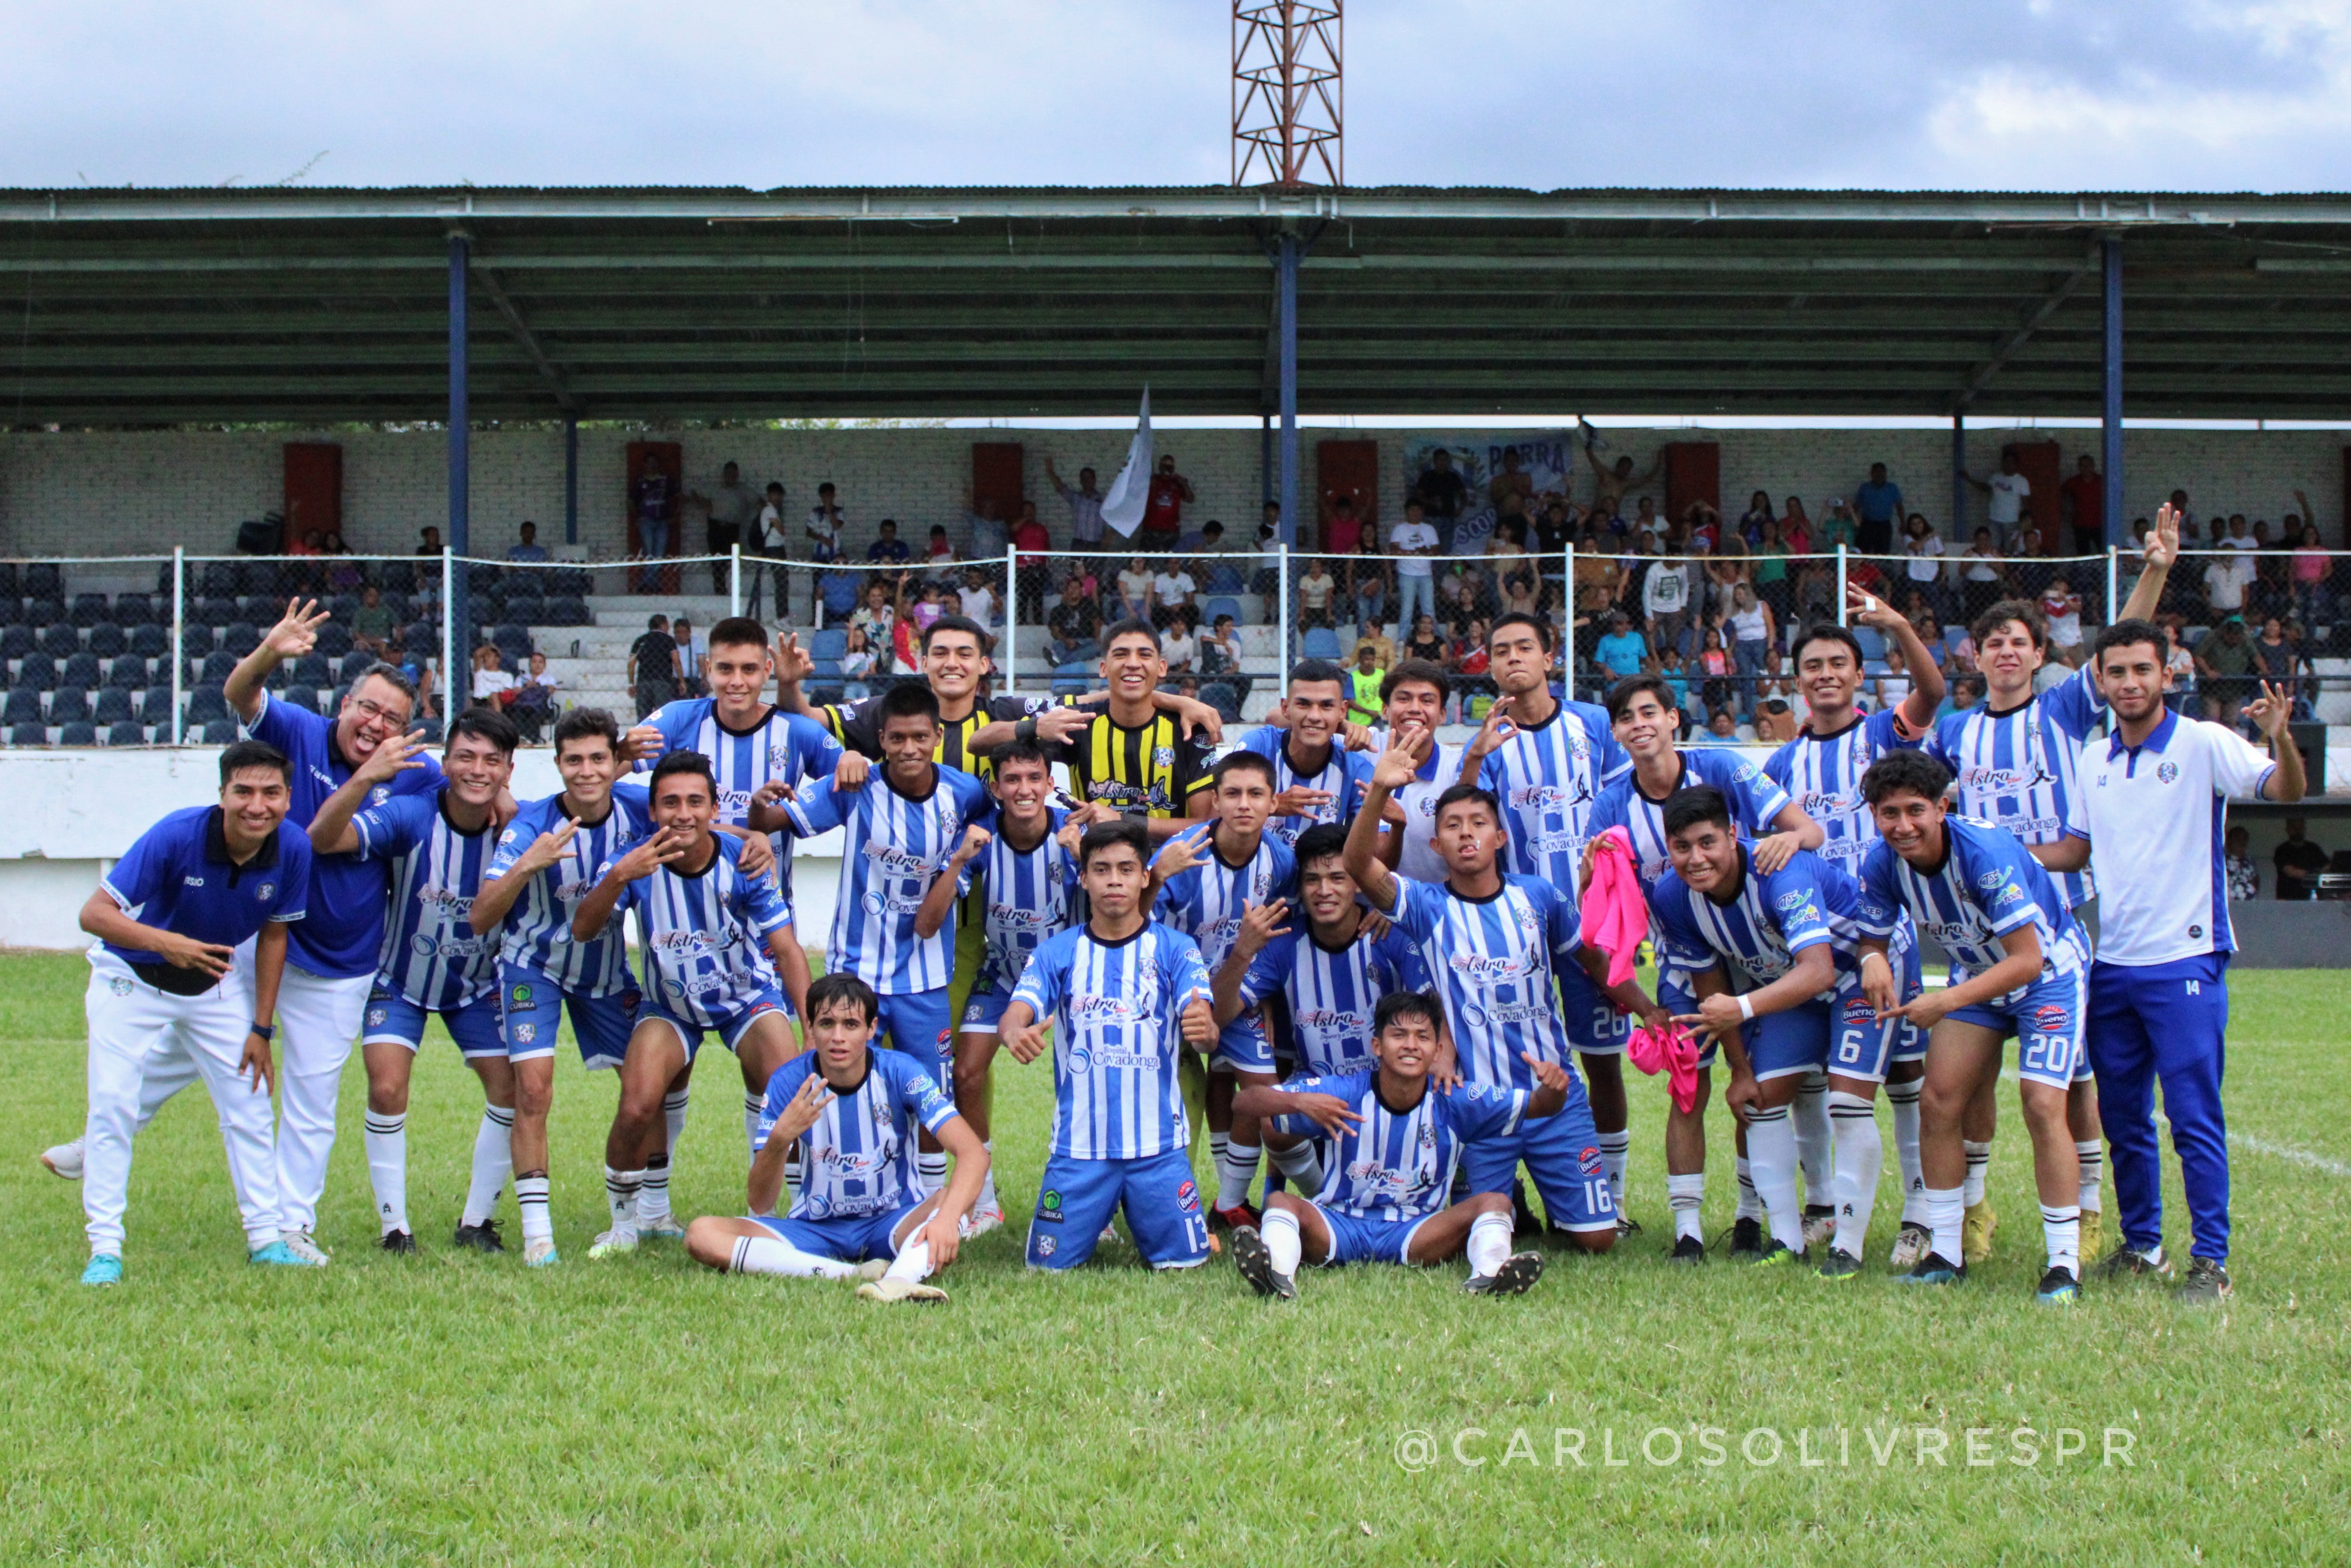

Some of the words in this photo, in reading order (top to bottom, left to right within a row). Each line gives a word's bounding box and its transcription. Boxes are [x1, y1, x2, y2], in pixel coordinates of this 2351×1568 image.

[1488, 444, 1566, 474] PRRA
[2097, 775, 2107, 788] 14
[716, 791, 749, 804] stro
[1546, 831, 1570, 840] Hospital
[868, 848, 920, 866] Astro
[183, 876, 204, 887] FISIO
[655, 932, 704, 950] Astro
[1455, 956, 1506, 973] Astro
[2186, 980, 2200, 996] 14
[1071, 996, 1118, 1016] Astro
[1497, 1003, 1523, 1011] Hospital
[1843, 1009, 1876, 1019] Bueno
[1301, 1011, 1354, 1028] Astro
[1593, 1006, 1625, 1039] 26
[1838, 1030, 1863, 1064] 6
[2026, 1033, 2069, 1072] 20
[1093, 1050, 1158, 1071] Covadonga
[1345, 1058, 1371, 1066] Hospital
[812, 1148, 857, 1166] Astro
[833, 1188, 902, 1212] Covadonga
[845, 1195, 872, 1203] Hospital
[1583, 1179, 1612, 1215] 16
[1185, 1214, 1210, 1254] 13
